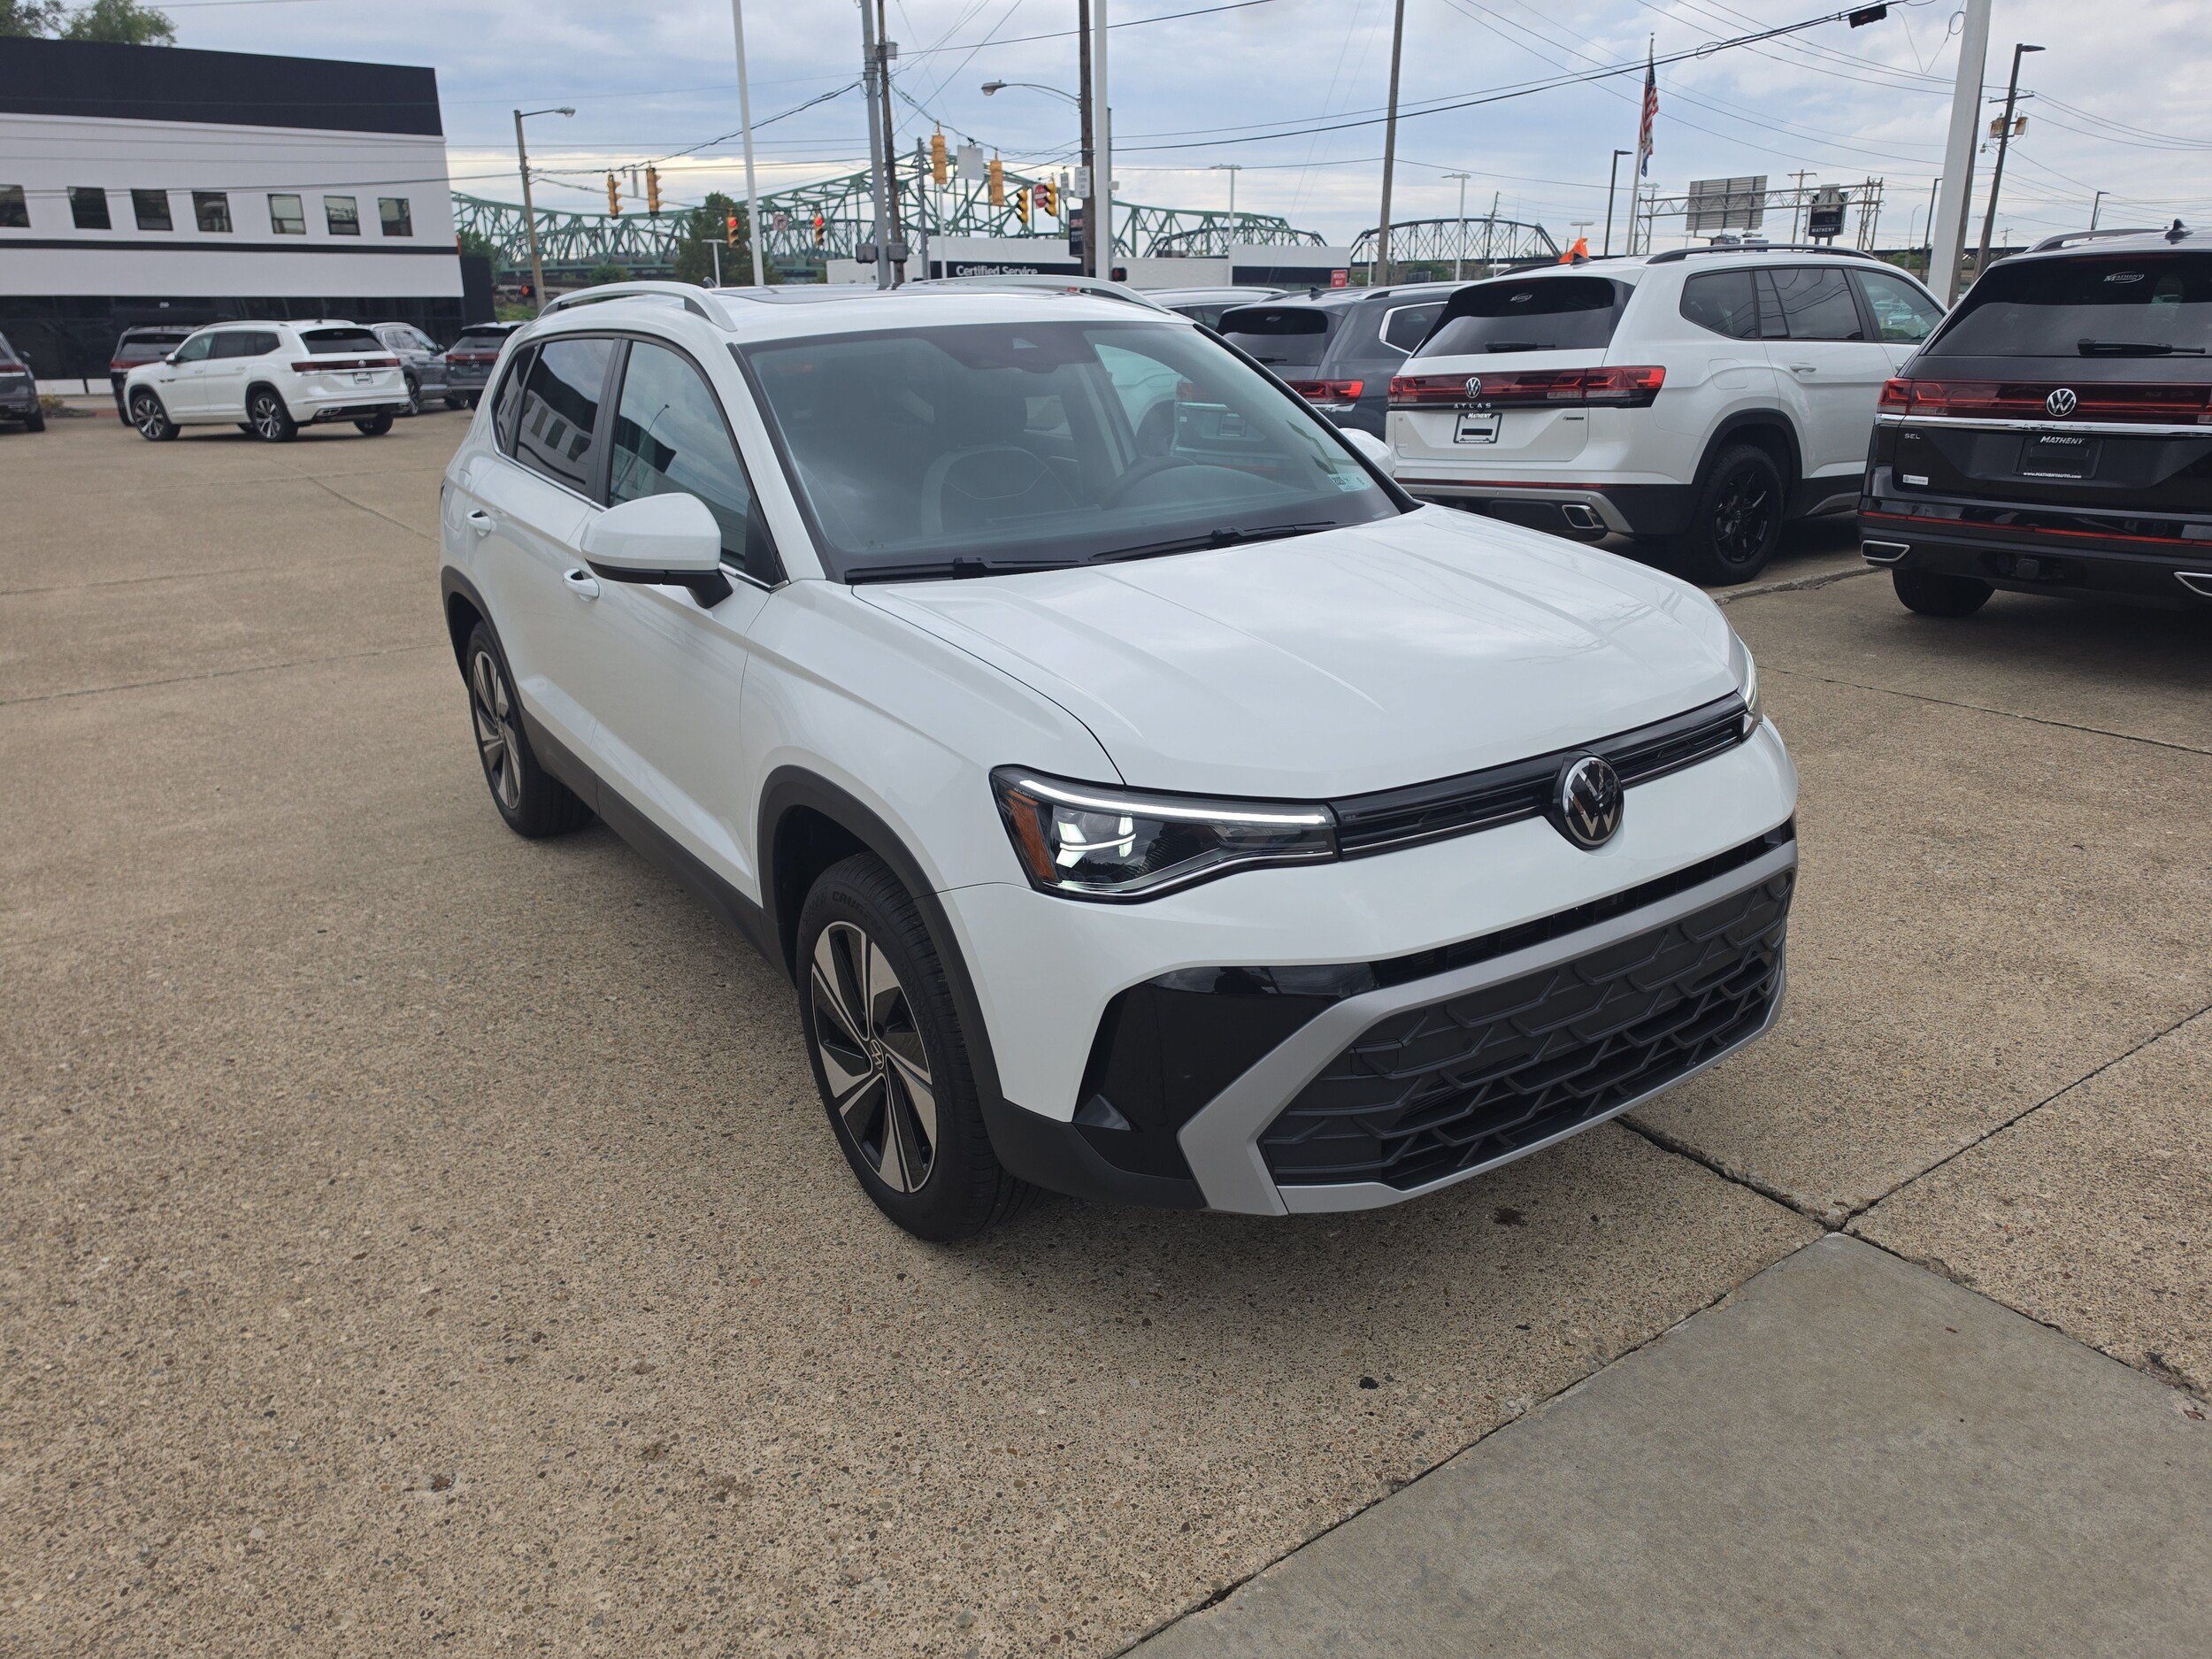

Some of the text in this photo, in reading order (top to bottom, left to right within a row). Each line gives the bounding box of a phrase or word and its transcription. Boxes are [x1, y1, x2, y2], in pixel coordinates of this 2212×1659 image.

[956, 265, 1039, 276] Certified Service
[2039, 435, 2085, 444] MATHENY
